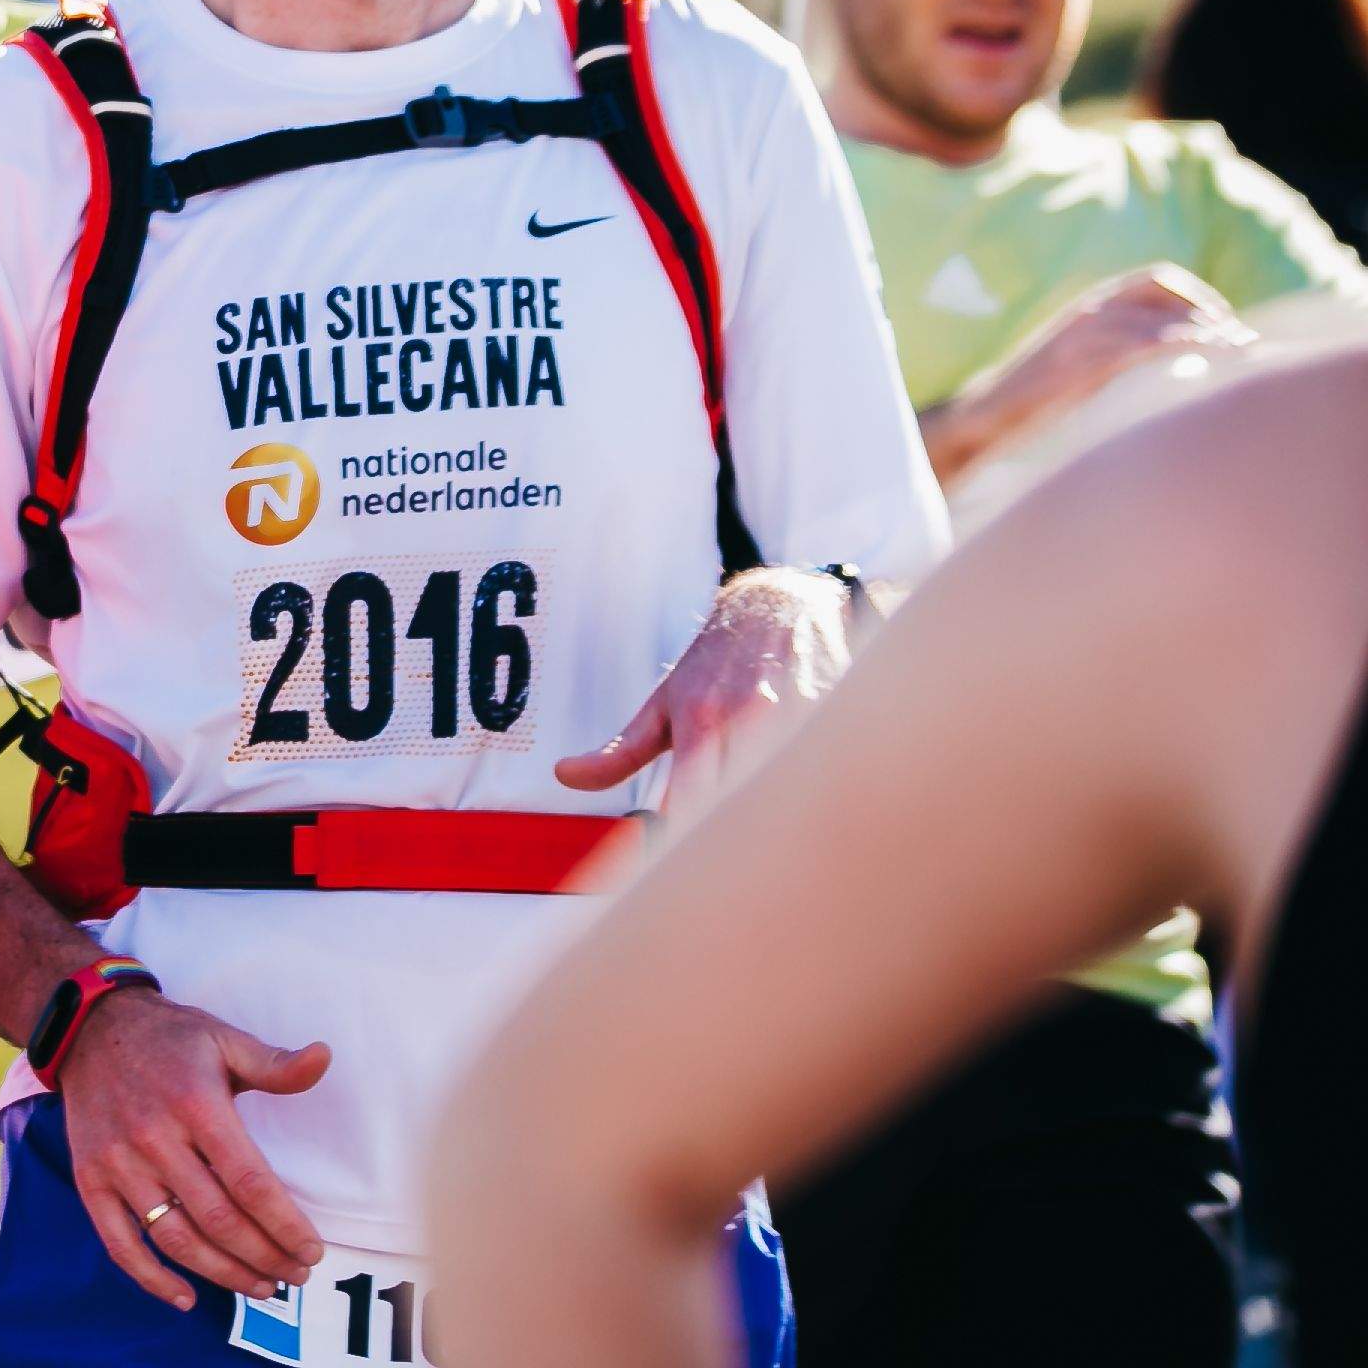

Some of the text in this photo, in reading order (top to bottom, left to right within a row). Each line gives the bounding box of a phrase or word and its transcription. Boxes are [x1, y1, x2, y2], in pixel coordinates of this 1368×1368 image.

[215, 277, 564, 355] SAN SILVESTRE
[216, 335, 565, 431] VALLECANA
[340, 440, 508, 480] nationale
[340, 477, 562, 517] nederlanden
[248, 560, 538, 747] 2016
[334, 1271, 436, 1367] 11
